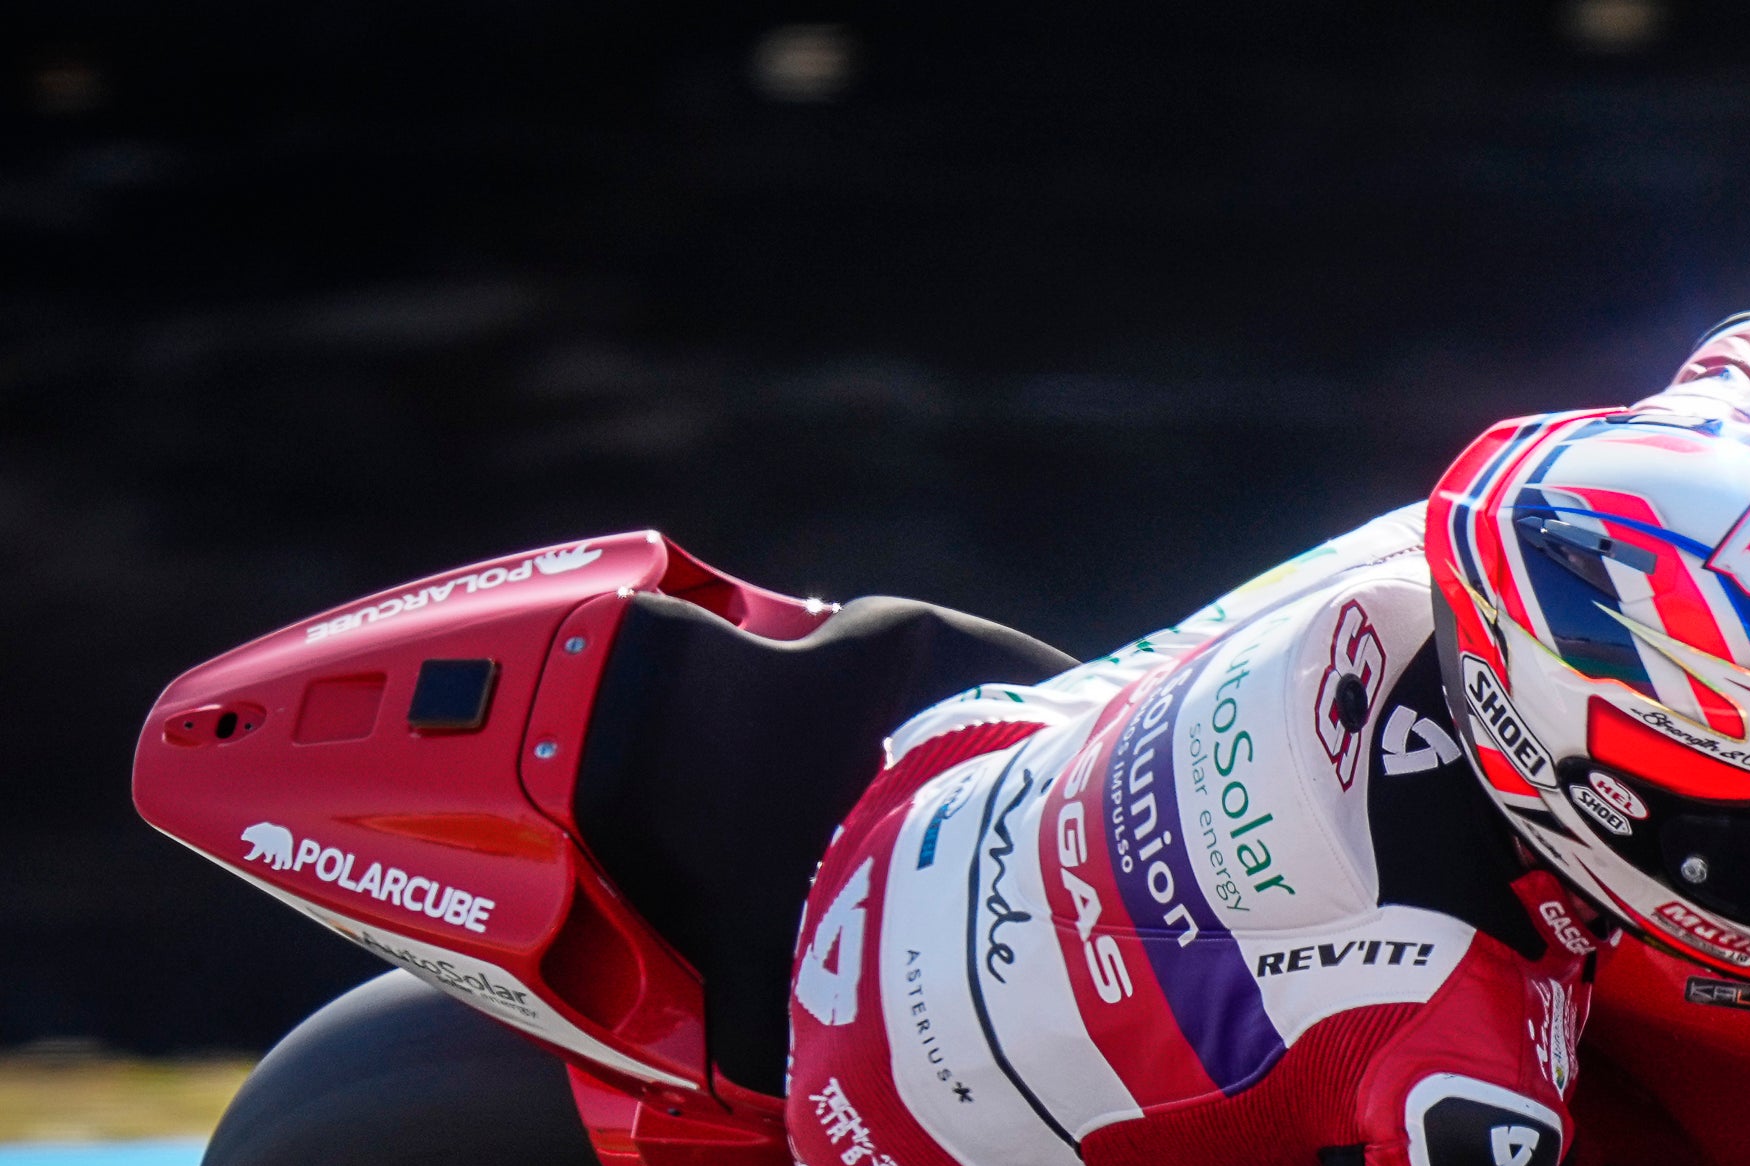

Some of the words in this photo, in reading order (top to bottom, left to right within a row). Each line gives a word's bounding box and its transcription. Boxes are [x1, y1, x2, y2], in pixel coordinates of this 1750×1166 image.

[304, 560, 534, 644] POLARCUBE
[1468, 670, 1547, 777] SHOEI
[1111, 761, 1133, 873] IMPULSO
[1187, 722, 1209, 796] solar
[1198, 809, 1251, 913] energy
[1578, 790, 1624, 831] SHOEI
[1597, 780, 1635, 815] HEL
[293, 838, 495, 933] POLARCUBE
[1256, 942, 1435, 978] REV'IT!
[906, 949, 953, 1082] ASTERIUS
